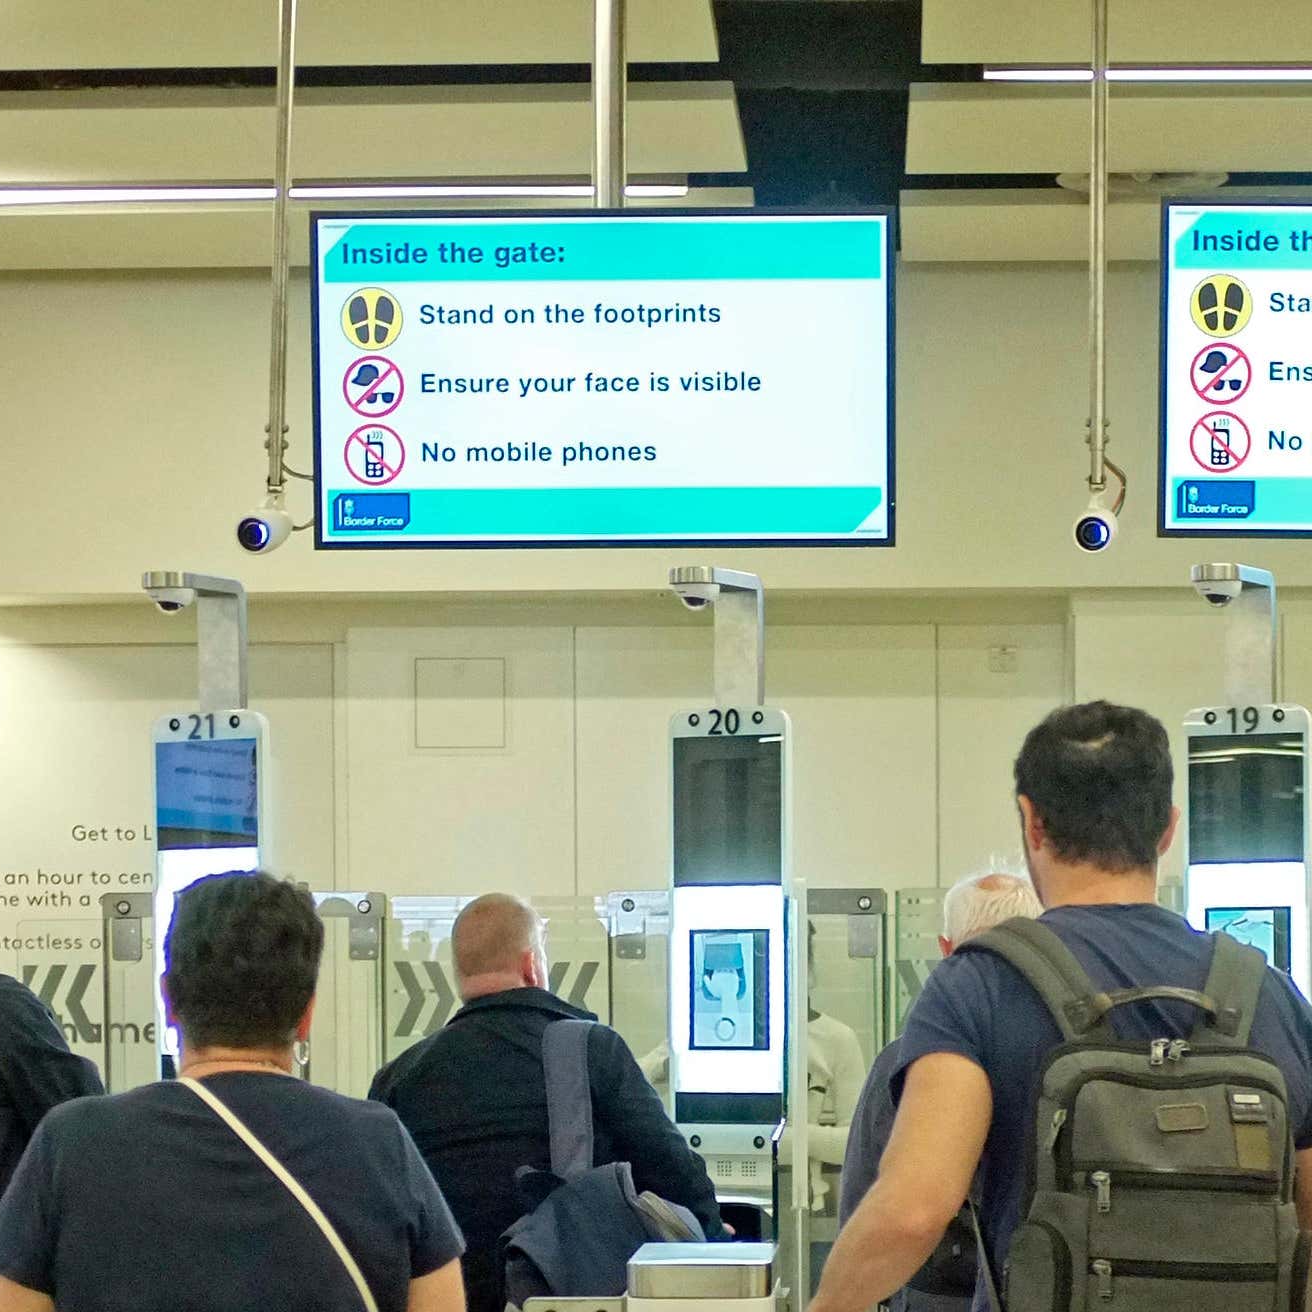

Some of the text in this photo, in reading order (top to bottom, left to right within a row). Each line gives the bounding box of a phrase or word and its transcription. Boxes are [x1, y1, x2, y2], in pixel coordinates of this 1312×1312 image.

[1193, 230, 1280, 252] Inside
[342, 242, 565, 268] Inside the gate:
[420, 302, 721, 328] Stand on the footprints
[421, 372, 761, 397] Ensure your face is visible
[1268, 431, 1302, 451] No
[422, 442, 656, 466] No mobile phones
[188, 714, 214, 739] 21
[707, 709, 740, 735] 20
[1227, 707, 1259, 733] 19
[72, 824, 108, 842] Get
[115, 826, 136, 842] to
[5, 873, 30, 886] an
[37, 868, 83, 886] hour
[90, 871, 111, 886] to
[26, 890, 72, 908] with
[79, 895, 90, 908] a
